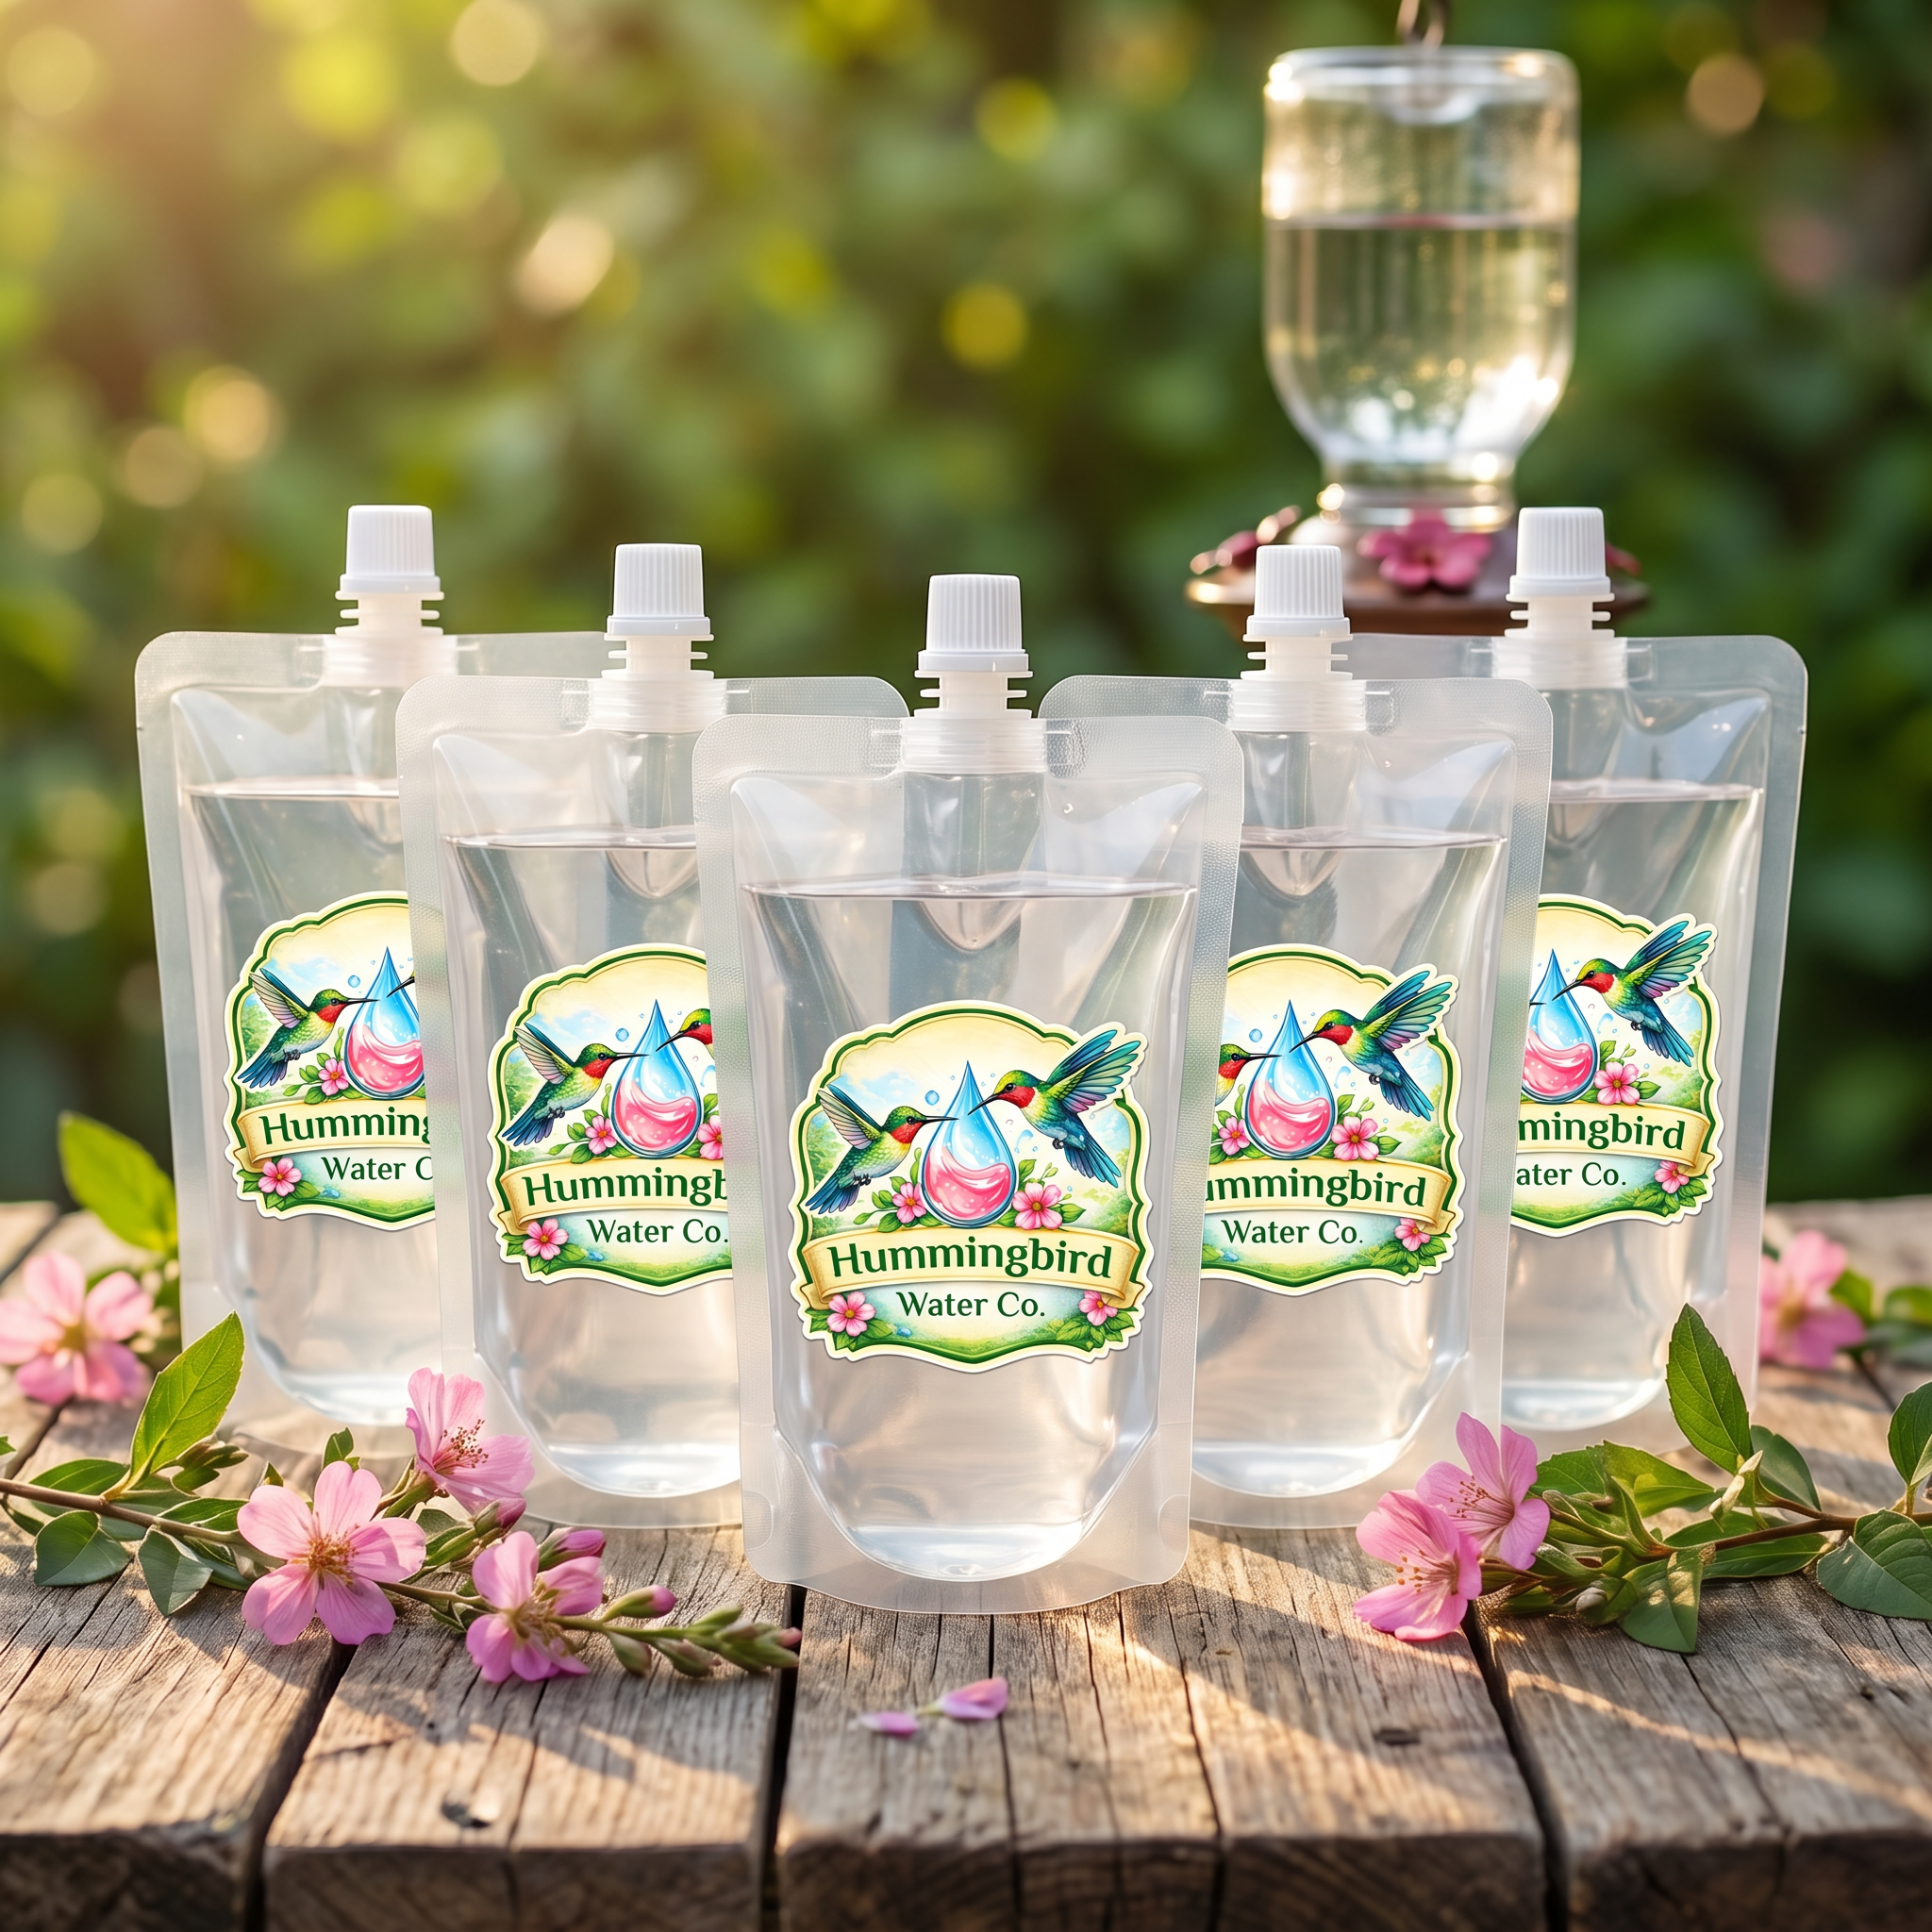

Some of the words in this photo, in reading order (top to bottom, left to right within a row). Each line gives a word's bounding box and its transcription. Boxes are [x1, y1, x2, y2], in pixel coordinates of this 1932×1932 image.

[320, 1157, 407, 1180] Water
[1516, 1163, 1573, 1186] ater
[1581, 1161, 1626, 1186] Co.
[586, 1219, 675, 1243] Water
[682, 1218, 728, 1243] Co.
[1221, 1220, 1310, 1244] Water
[1318, 1219, 1363, 1244] Co.
[826, 1236, 1112, 1278] Hummingbird
[895, 1291, 989, 1317] Water
[997, 1291, 1045, 1317] Co.
